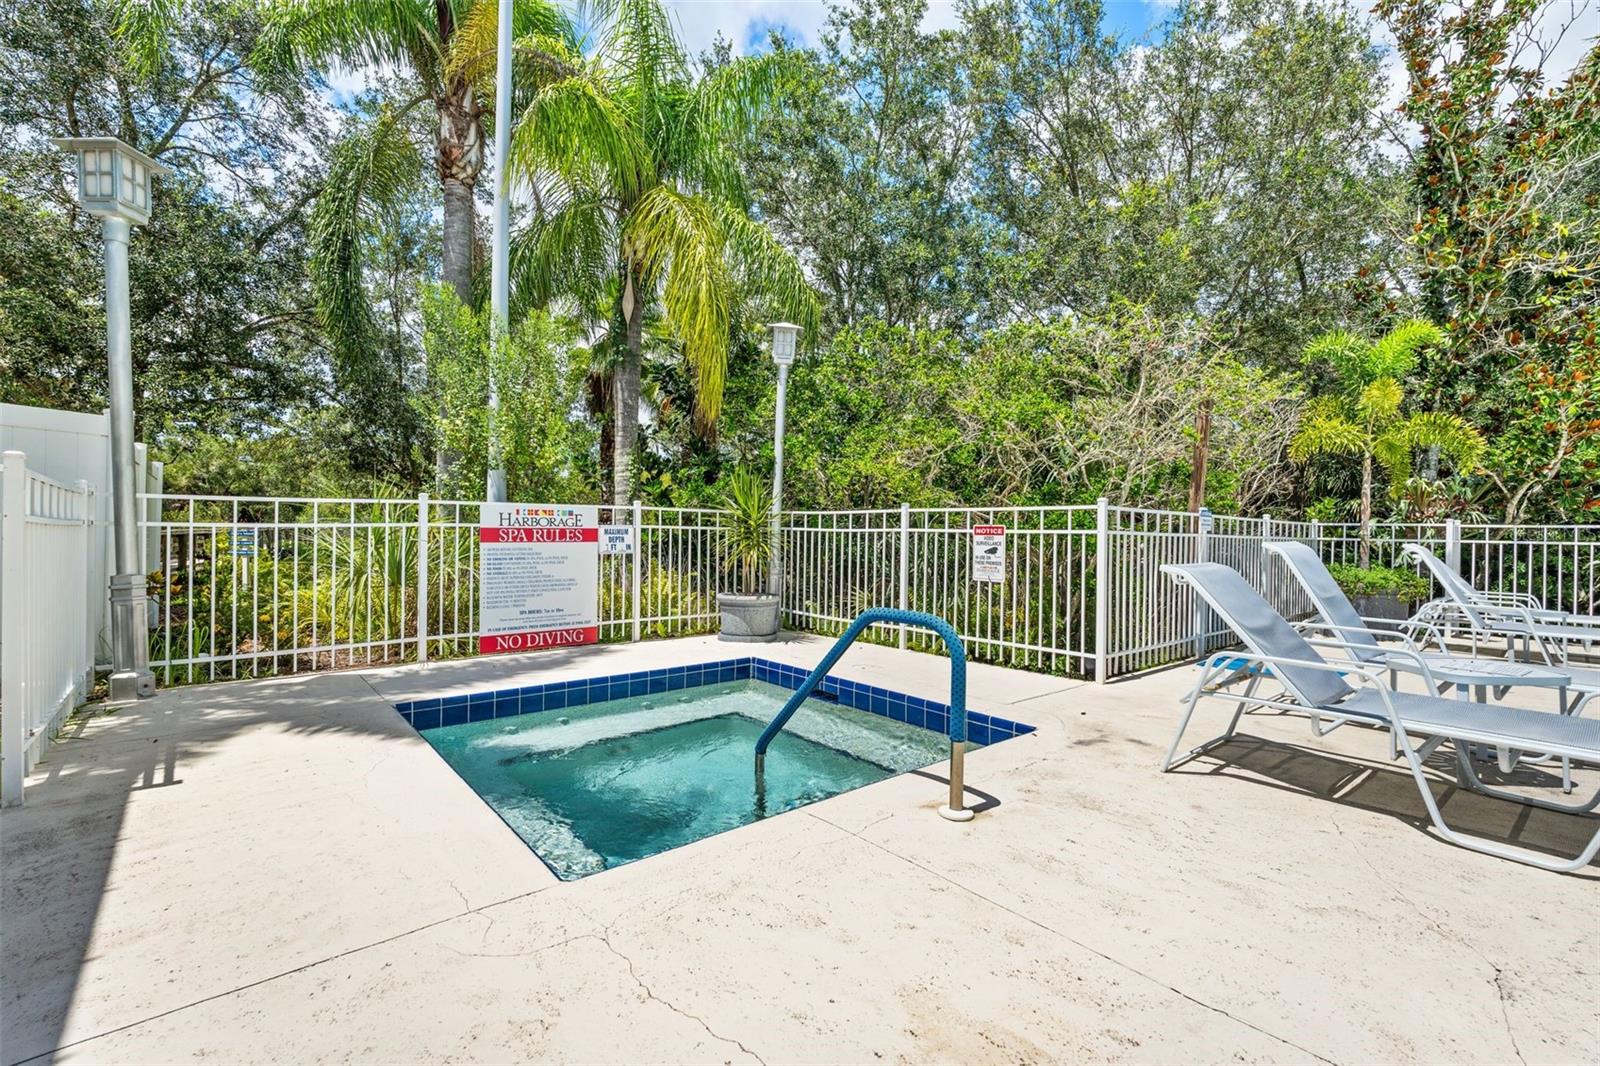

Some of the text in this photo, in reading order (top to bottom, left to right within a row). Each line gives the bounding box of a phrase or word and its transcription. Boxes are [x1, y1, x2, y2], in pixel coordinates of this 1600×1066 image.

[499, 512, 583, 527] HARBORAGE
[499, 528, 583, 542] SPA RULES
[496, 629, 584, 650] NO DIVING
